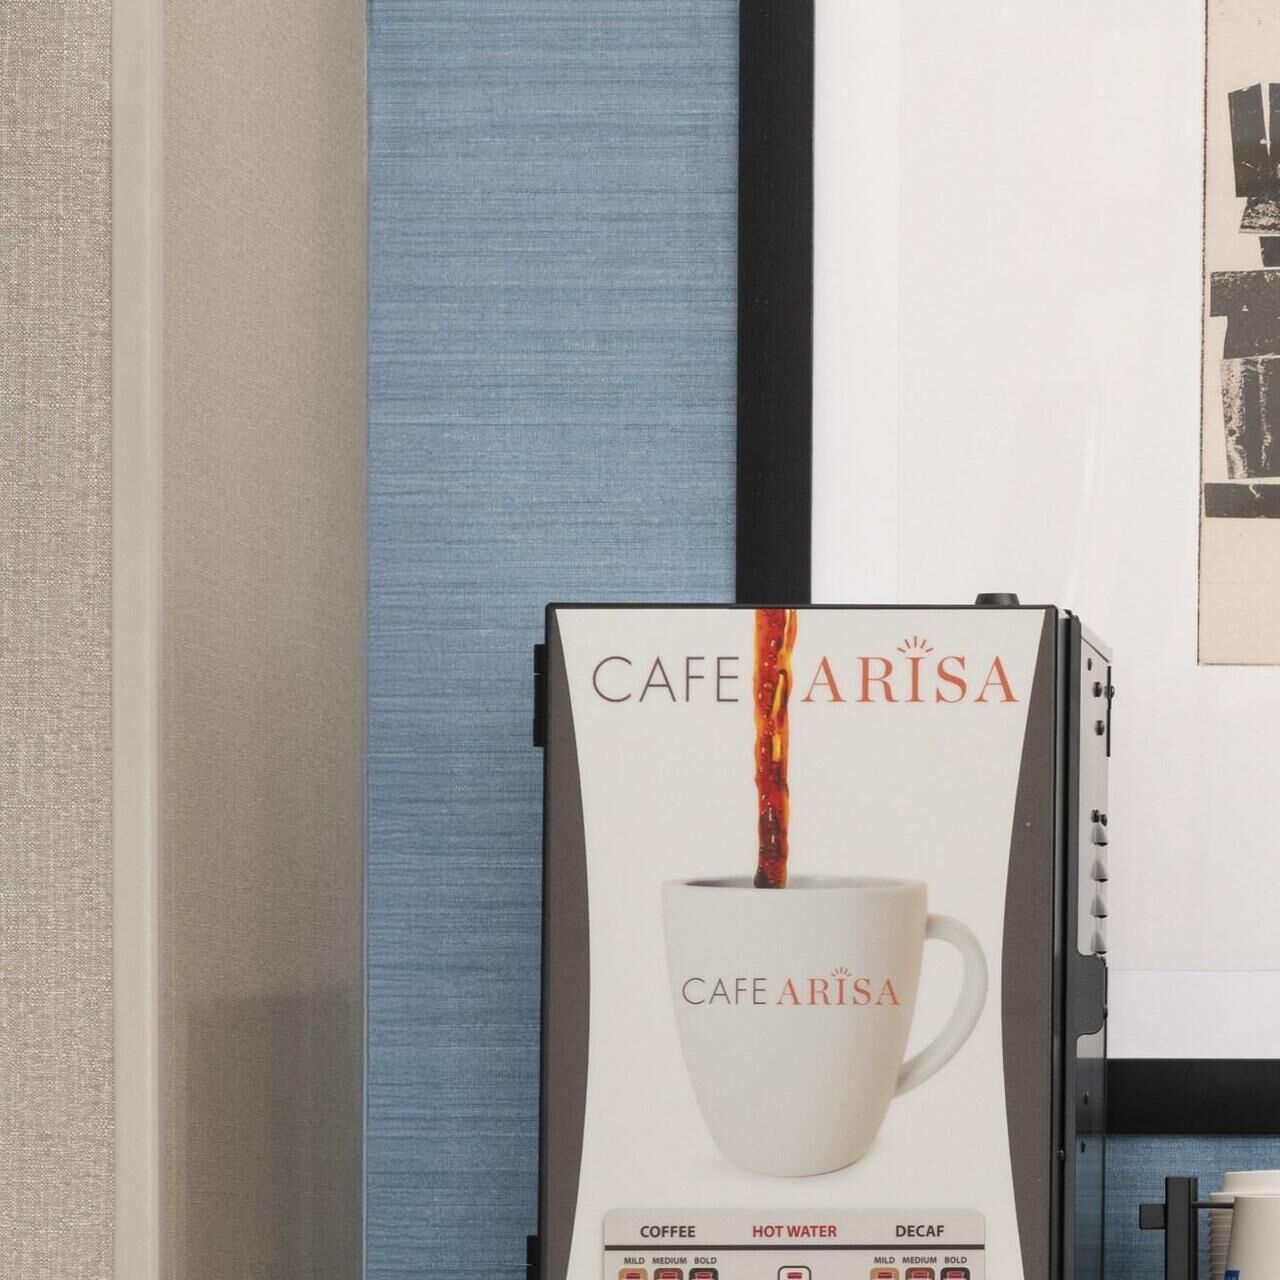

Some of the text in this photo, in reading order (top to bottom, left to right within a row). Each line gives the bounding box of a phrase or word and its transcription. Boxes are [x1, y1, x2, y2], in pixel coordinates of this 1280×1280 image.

[592, 654, 1020, 703] CAFE ARISA
[681, 977, 901, 1006] CAFE ARISA
[640, 1225, 696, 1238] COFFEE
[752, 1225, 838, 1238] HOT WATER
[895, 1225, 945, 1238] DECAF
[623, 1257, 645, 1265] MILD
[652, 1257, 687, 1265] MEDIUM
[694, 1257, 717, 1265] BOLD
[873, 1256, 896, 1264] MILD
[902, 1256, 937, 1264] MEDIUM
[944, 1256, 967, 1264] BOLD
